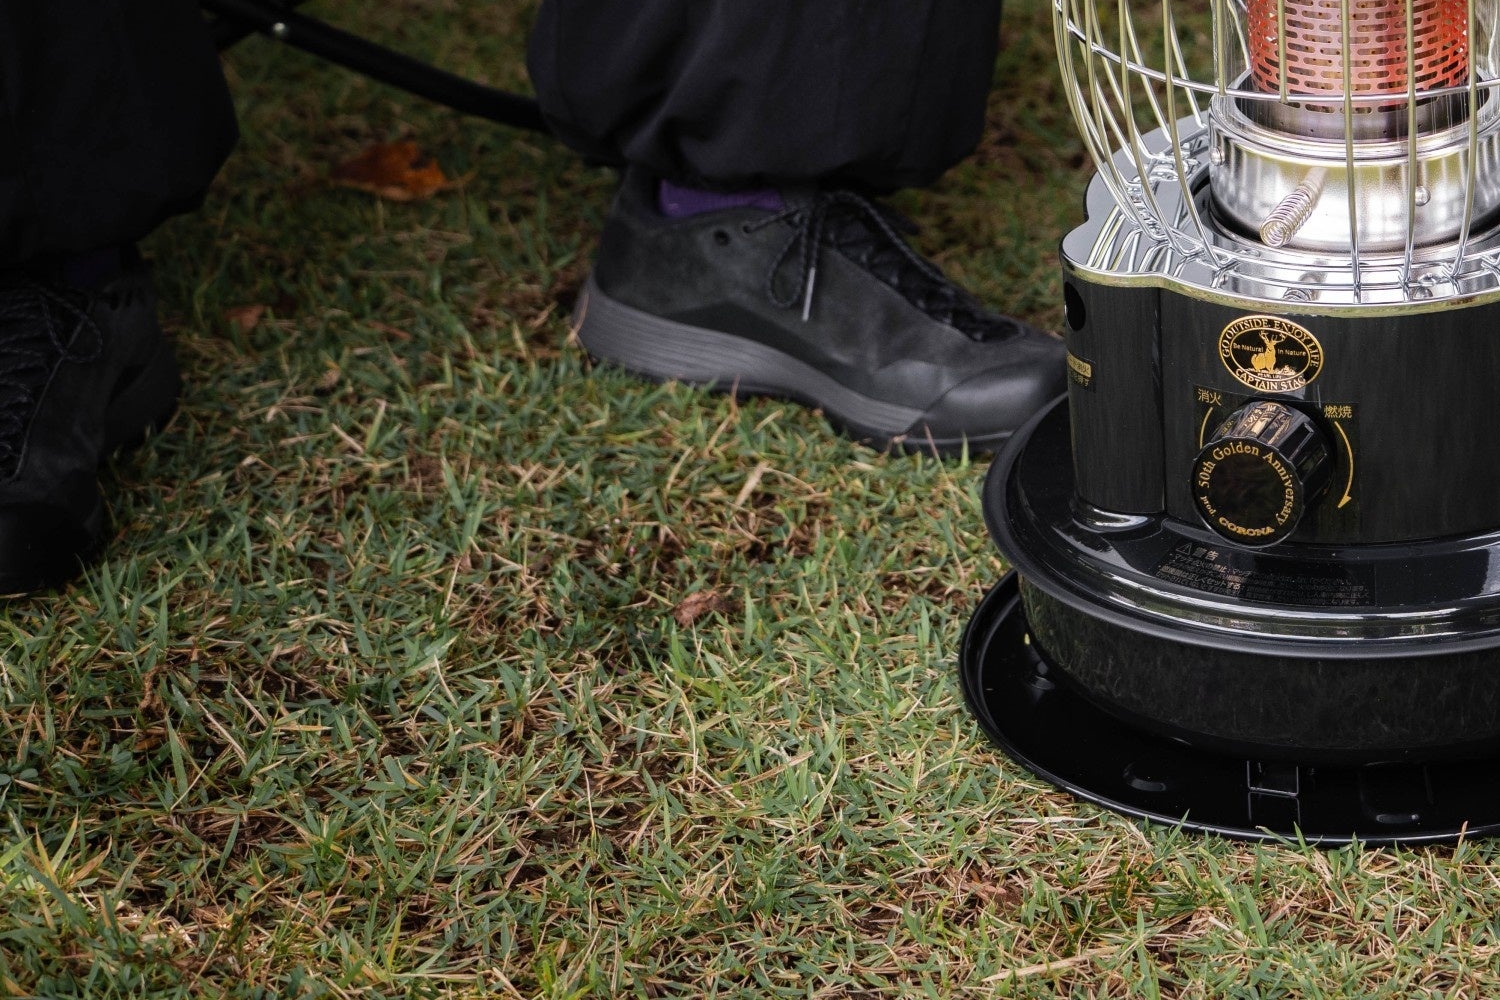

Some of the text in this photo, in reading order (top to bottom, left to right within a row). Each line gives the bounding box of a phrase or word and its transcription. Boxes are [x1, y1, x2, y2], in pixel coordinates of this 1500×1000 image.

[1222, 340, 1231, 358] GO
[1274, 320, 1311, 343] ENJOY
[1306, 342, 1320, 368] LIFE
[1232, 342, 1264, 353] Be Natural
[1285, 349, 1307, 357] Nature
[1235, 368, 1306, 391] CAPTAIN STAG
[1198, 388, 1222, 406] 消火
[1323, 405, 1353, 419] 燃焼
[1198, 441, 1295, 526] 50th Golden Anniversary
[1218, 516, 1275, 537] CORONA
